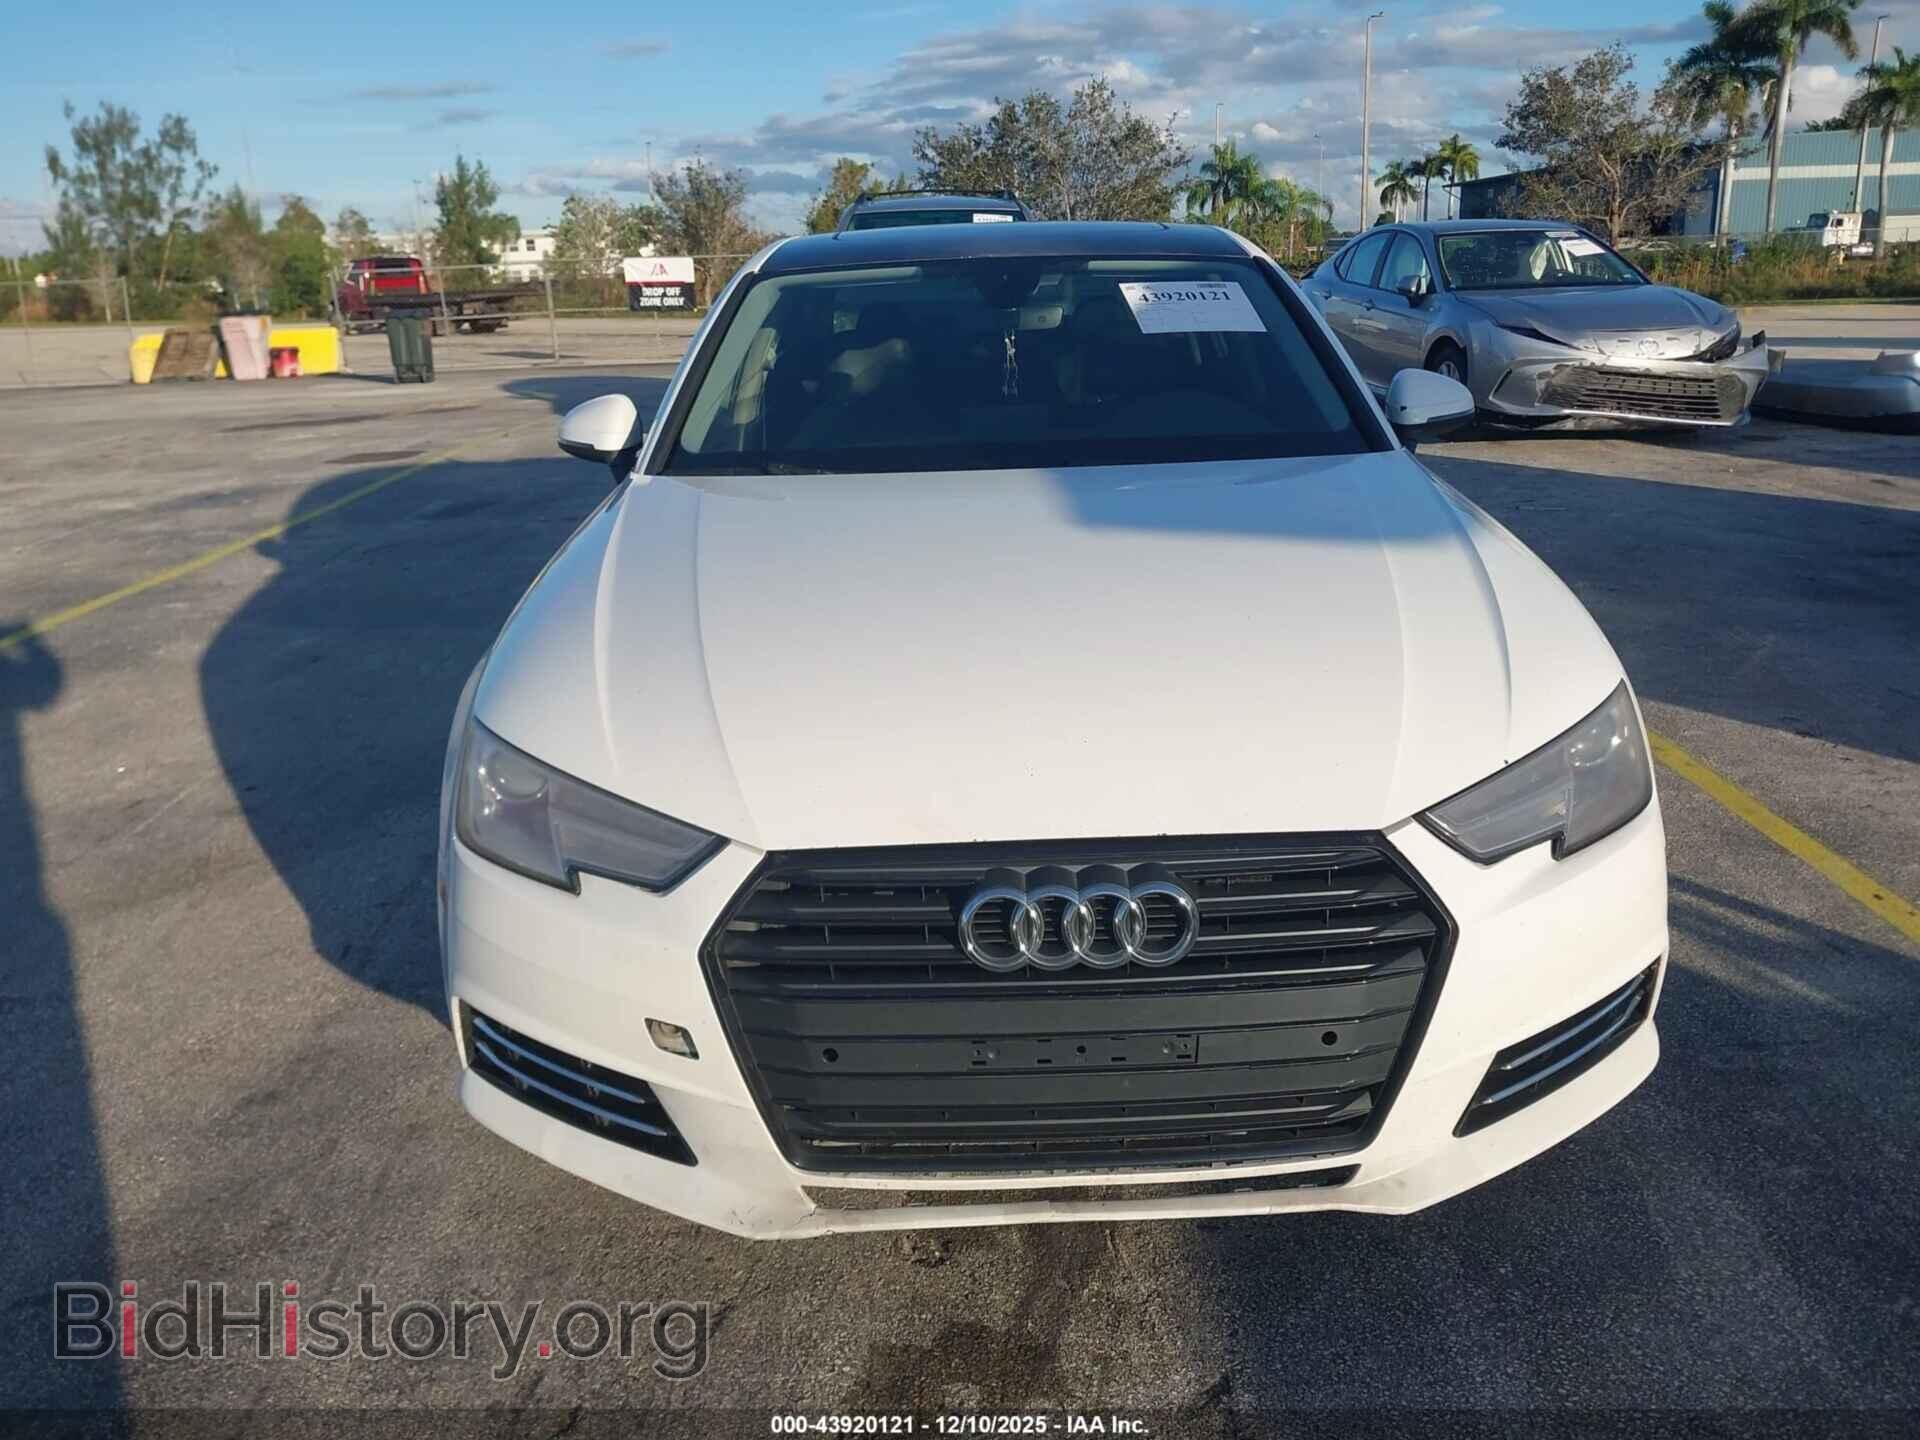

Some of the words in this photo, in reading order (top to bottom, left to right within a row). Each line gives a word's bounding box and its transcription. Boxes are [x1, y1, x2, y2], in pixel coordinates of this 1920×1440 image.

[642, 287, 664, 296] DROP
[666, 287, 681, 296] OFF
[1138, 290, 1232, 303] 43920121
[663, 297, 685, 306] ONLY
